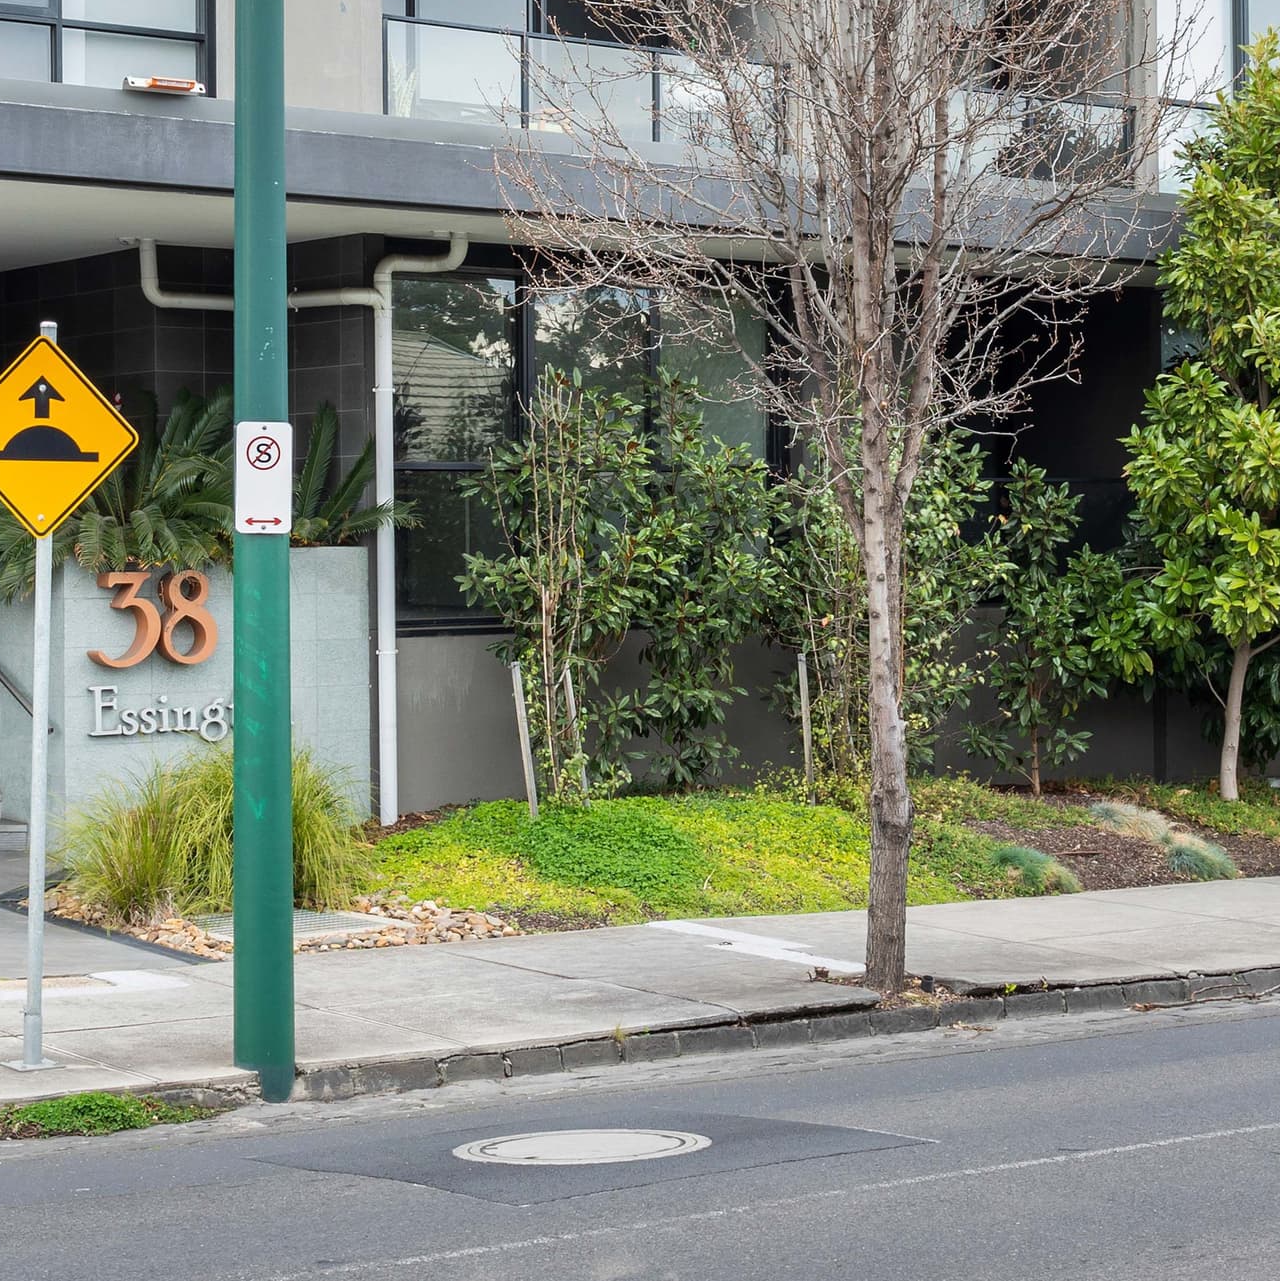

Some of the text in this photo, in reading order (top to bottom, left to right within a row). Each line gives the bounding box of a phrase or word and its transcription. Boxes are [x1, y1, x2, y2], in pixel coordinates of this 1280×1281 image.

[256, 443, 272, 463] S
[87, 570, 219, 669] 38
[88, 684, 235, 743] Essing
